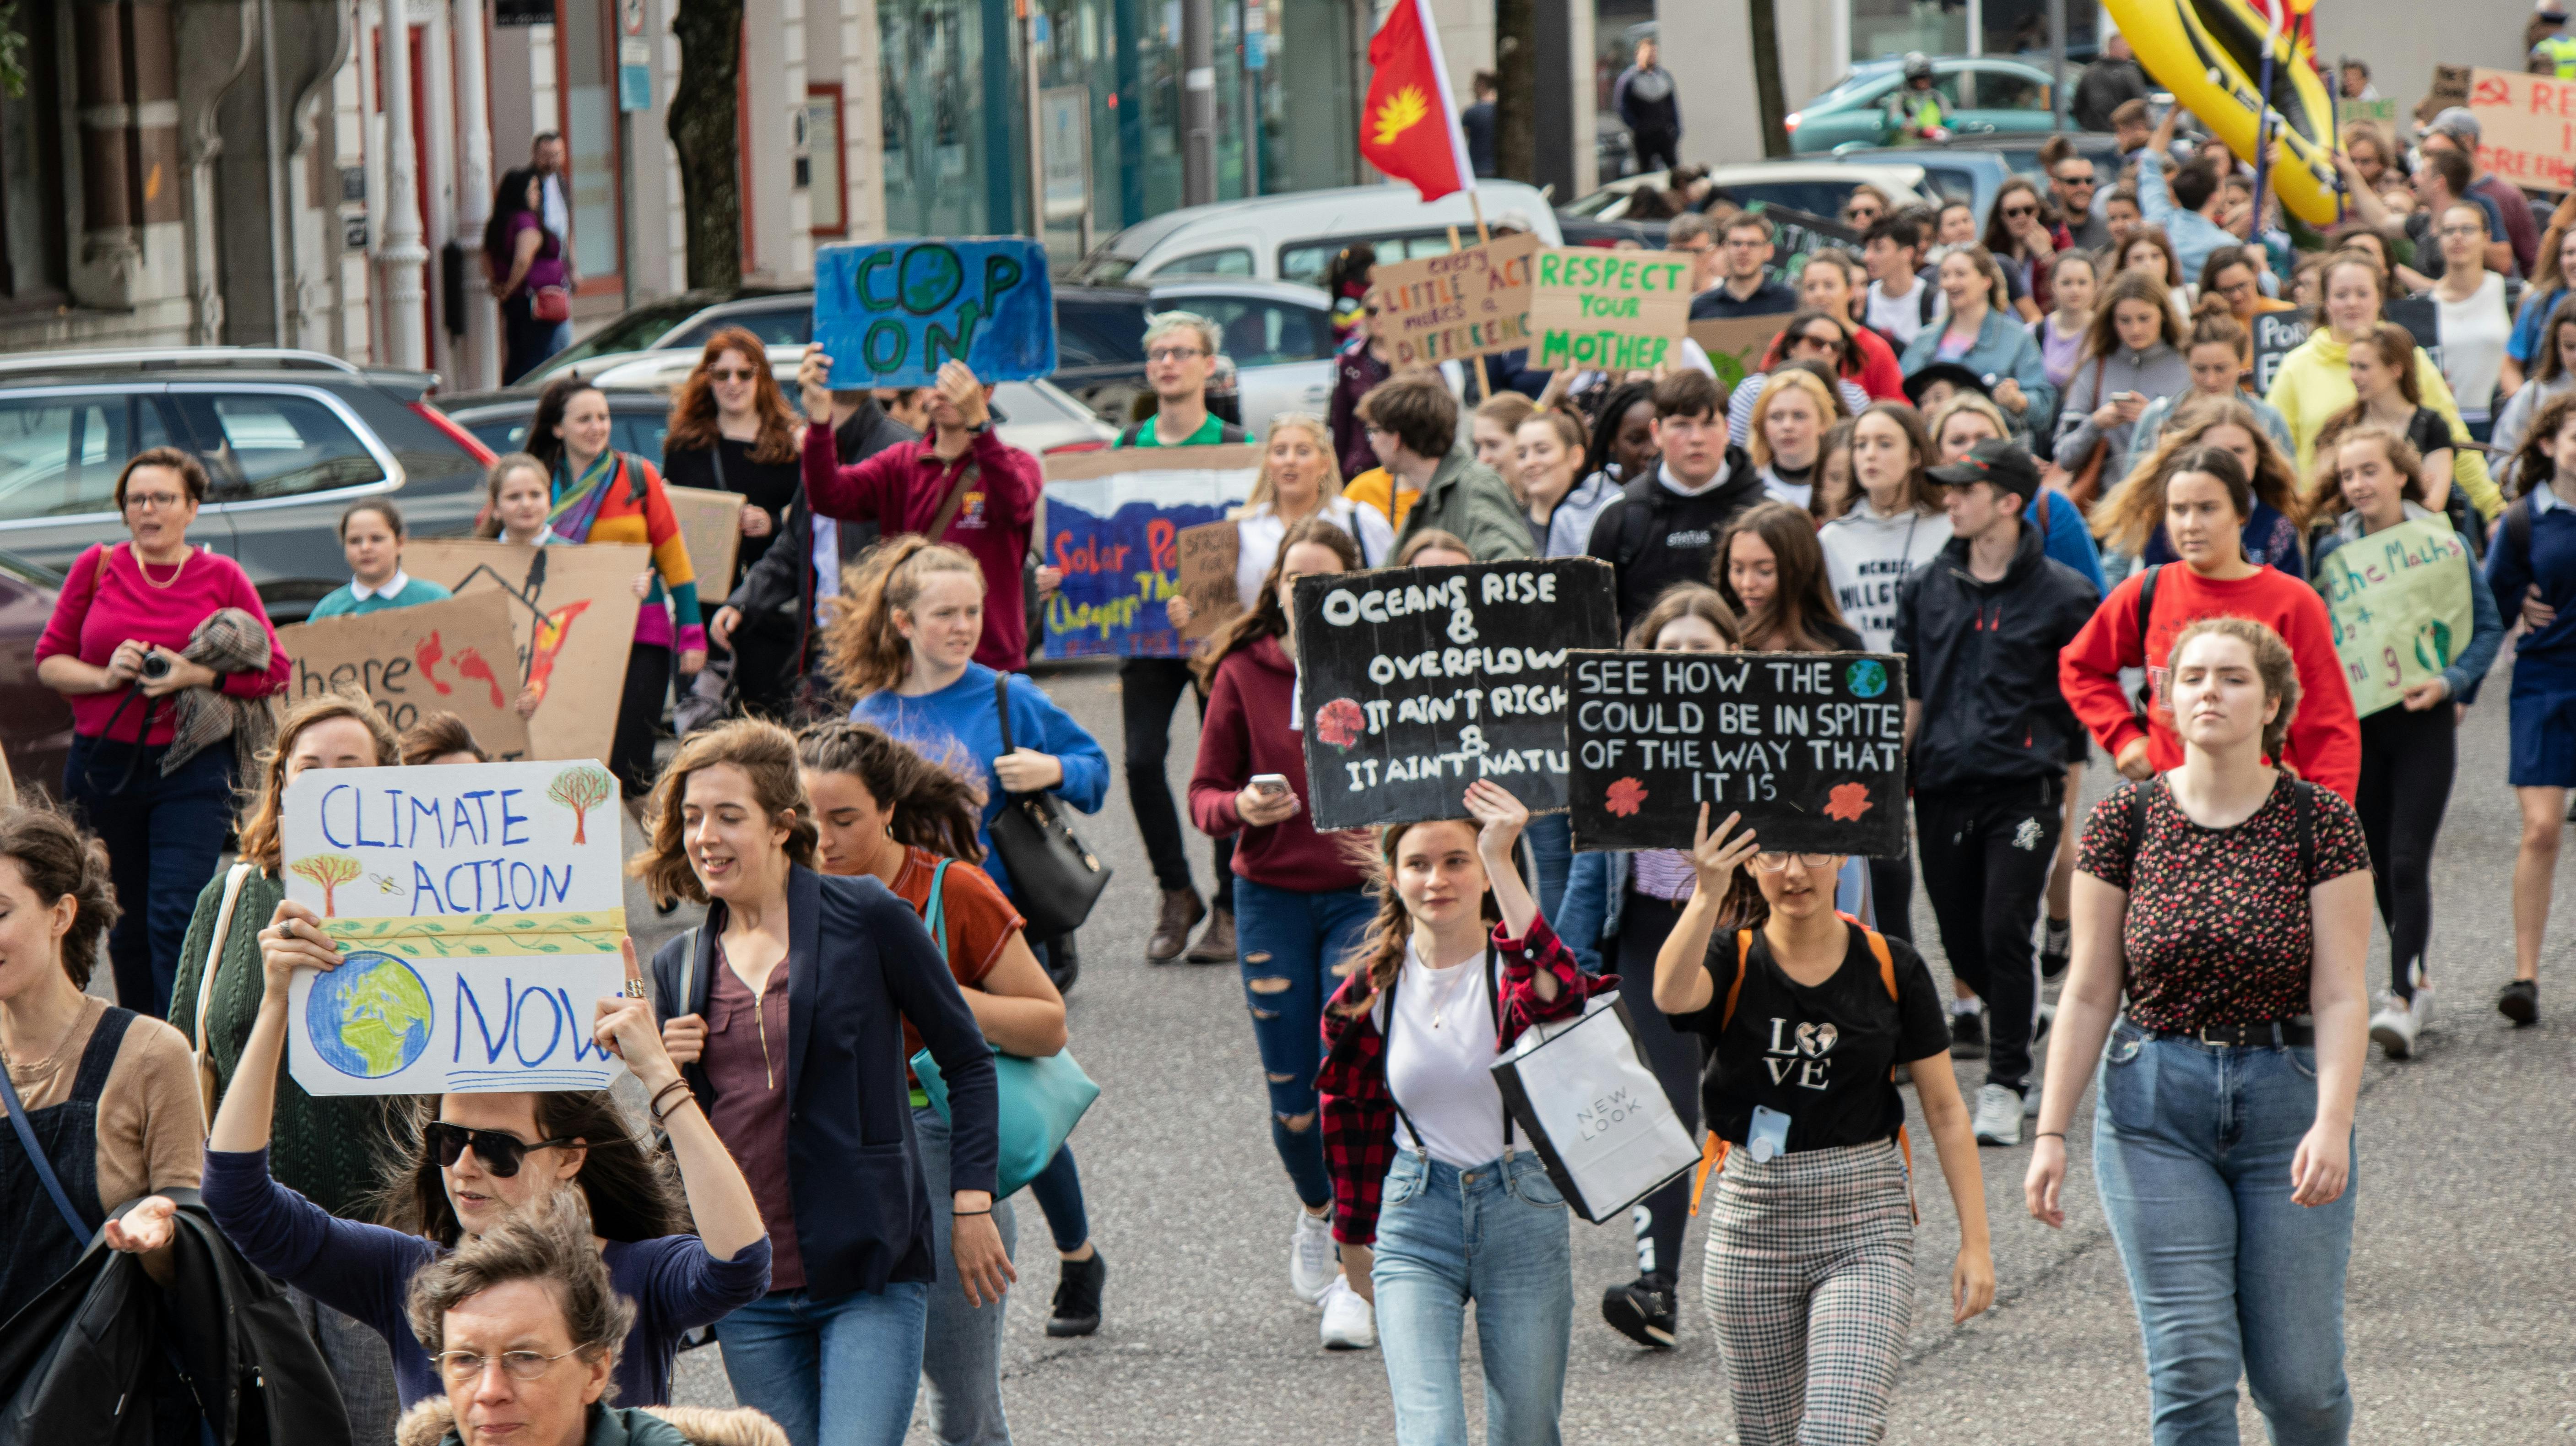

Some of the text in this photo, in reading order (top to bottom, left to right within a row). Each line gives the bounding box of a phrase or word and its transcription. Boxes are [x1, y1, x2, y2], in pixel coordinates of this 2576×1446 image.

[856, 243, 1023, 318] COP
[1428, 250, 1488, 275] every
[1540, 253, 1686, 292] RESPECT
[1383, 254, 1532, 314] LITTLE ACT
[1403, 298, 1498, 332] makes a
[1579, 293, 1640, 318] YOUR
[862, 297, 981, 374] ON
[1541, 327, 1670, 369] MOTHER
[1053, 530, 1131, 577] Solar
[2384, 536, 2462, 574] Maths
[1322, 572, 1557, 626] OCEANS RISE
[1446, 607, 1479, 644] &
[1369, 647, 1568, 685] OVERFLOW
[1578, 660, 1834, 695] SEE HOW THE
[1364, 700, 1392, 735] IT
[1397, 688, 1483, 725] AIN'T
[1578, 700, 1900, 738] COULD BE IN SPITE
[1459, 724, 1490, 756] &
[1580, 738, 1900, 772] OF THE WAY THAT
[1345, 758, 1379, 792] IT
[1693, 771, 1777, 803] IT IS
[321, 784, 530, 849] CLIMATE
[411, 858, 572, 917] ACTION
[1576, 1086, 1627, 1123] NEW
[1580, 1098, 1642, 1142] LOOK
